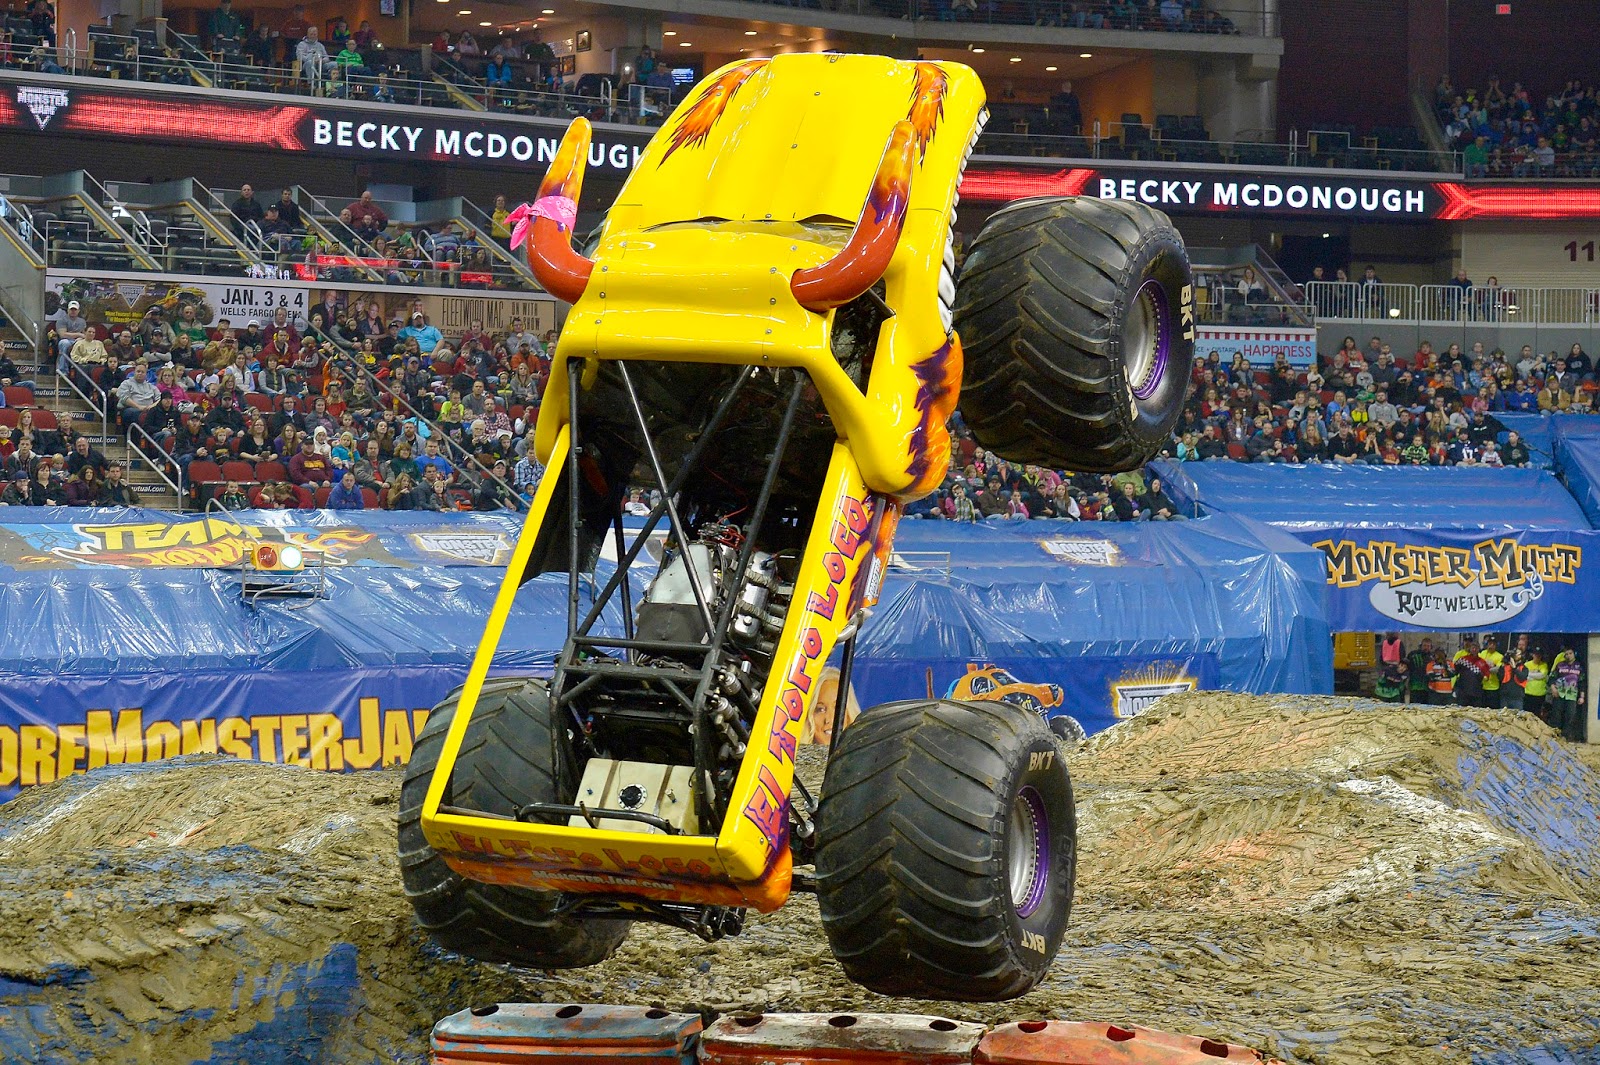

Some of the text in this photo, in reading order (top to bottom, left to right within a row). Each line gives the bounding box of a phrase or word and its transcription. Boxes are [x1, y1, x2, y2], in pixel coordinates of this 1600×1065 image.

[313, 119, 642, 169] BECKY MCDONUG
[1099, 178, 1424, 213] BECKY MCDONOUGH
[220, 306, 247, 317] WELLS
[248, 308, 275, 318] FARGO
[221, 288, 304, 308] JAN. 3 & 4
[442, 298, 504, 329] FLEETWOOD MAC
[1180, 284, 1195, 343] BKT
[1243, 344, 1312, 358] HAPPINESS
[85, 518, 263, 550] TEAM
[1315, 538, 1582, 588] MONSTER MUTT
[1395, 589, 1508, 617] ROTTWEILER
[1028, 750, 1054, 772] BKT
[1020, 928, 1046, 955] BKT
